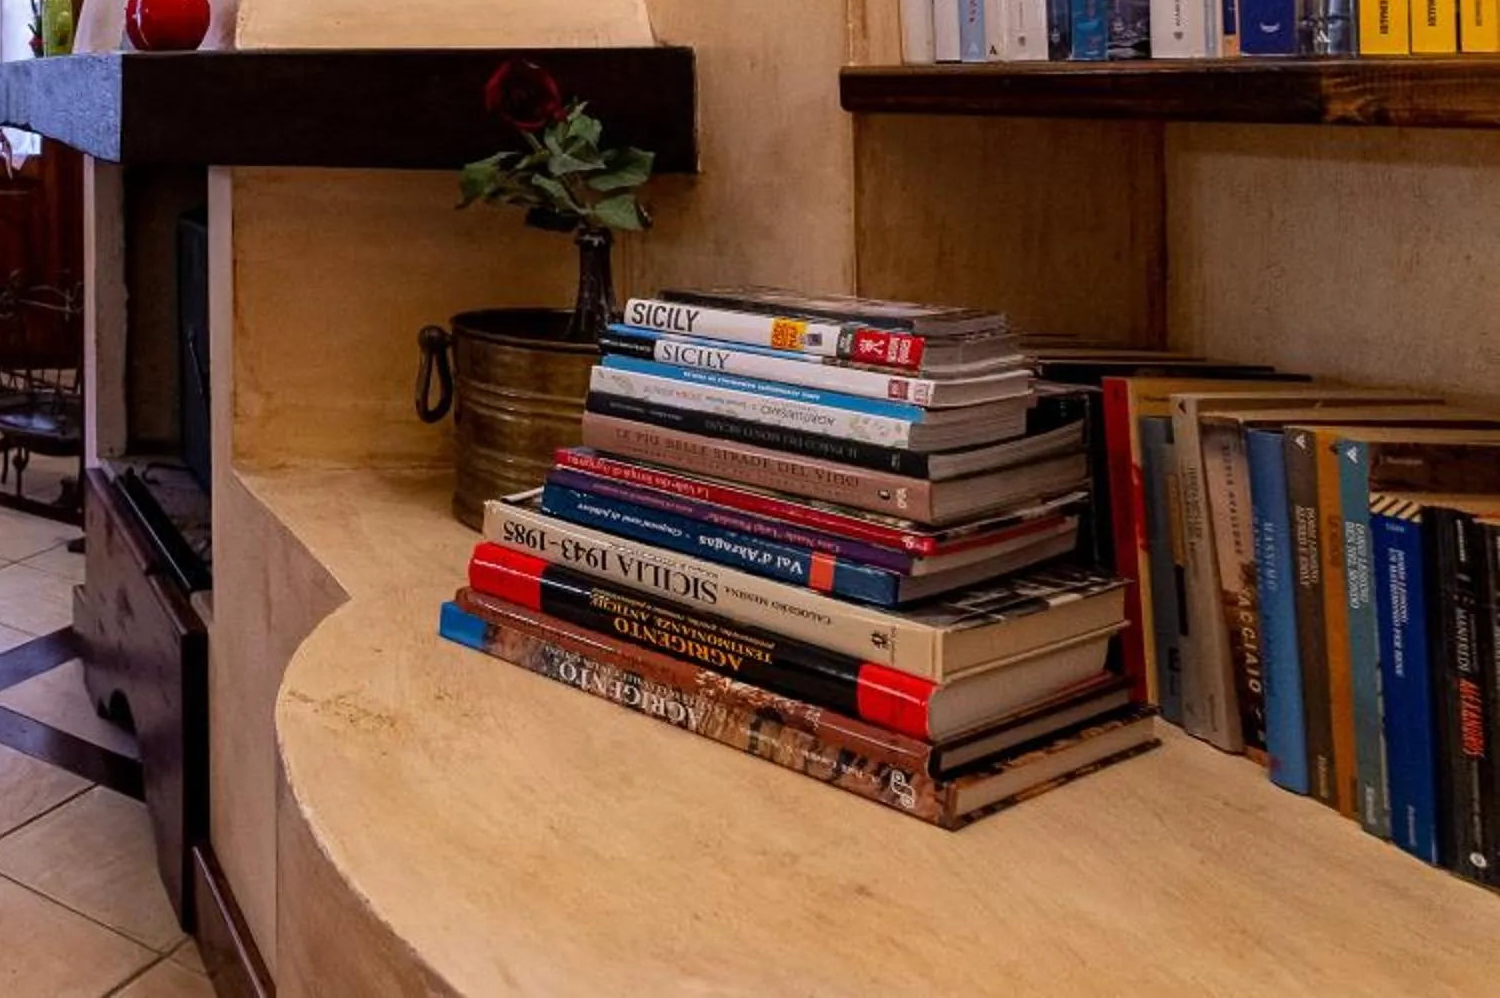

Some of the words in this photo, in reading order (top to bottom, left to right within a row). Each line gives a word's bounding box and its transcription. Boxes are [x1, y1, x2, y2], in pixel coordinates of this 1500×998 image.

[631, 302, 700, 333] SICILY
[661, 343, 731, 370] SICILY
[666, 435, 708, 456] BELLE
[713, 445, 769, 470] STRADE
[775, 459, 808, 478] DEL
[814, 467, 860, 489] VINO
[502, 520, 608, 570] 1943-1985
[698, 534, 773, 564] d'Akragas
[777, 556, 804, 576] Val
[618, 555, 719, 604] SICILIA
[613, 617, 744, 671] AGRIGENTO
[657, 617, 773, 664] TESTIMONIANZE
[1238, 595, 1262, 694] ACCIAIO
[1456, 606, 1472, 673] MANFREDI
[559, 661, 704, 731] AGRIGENTO
